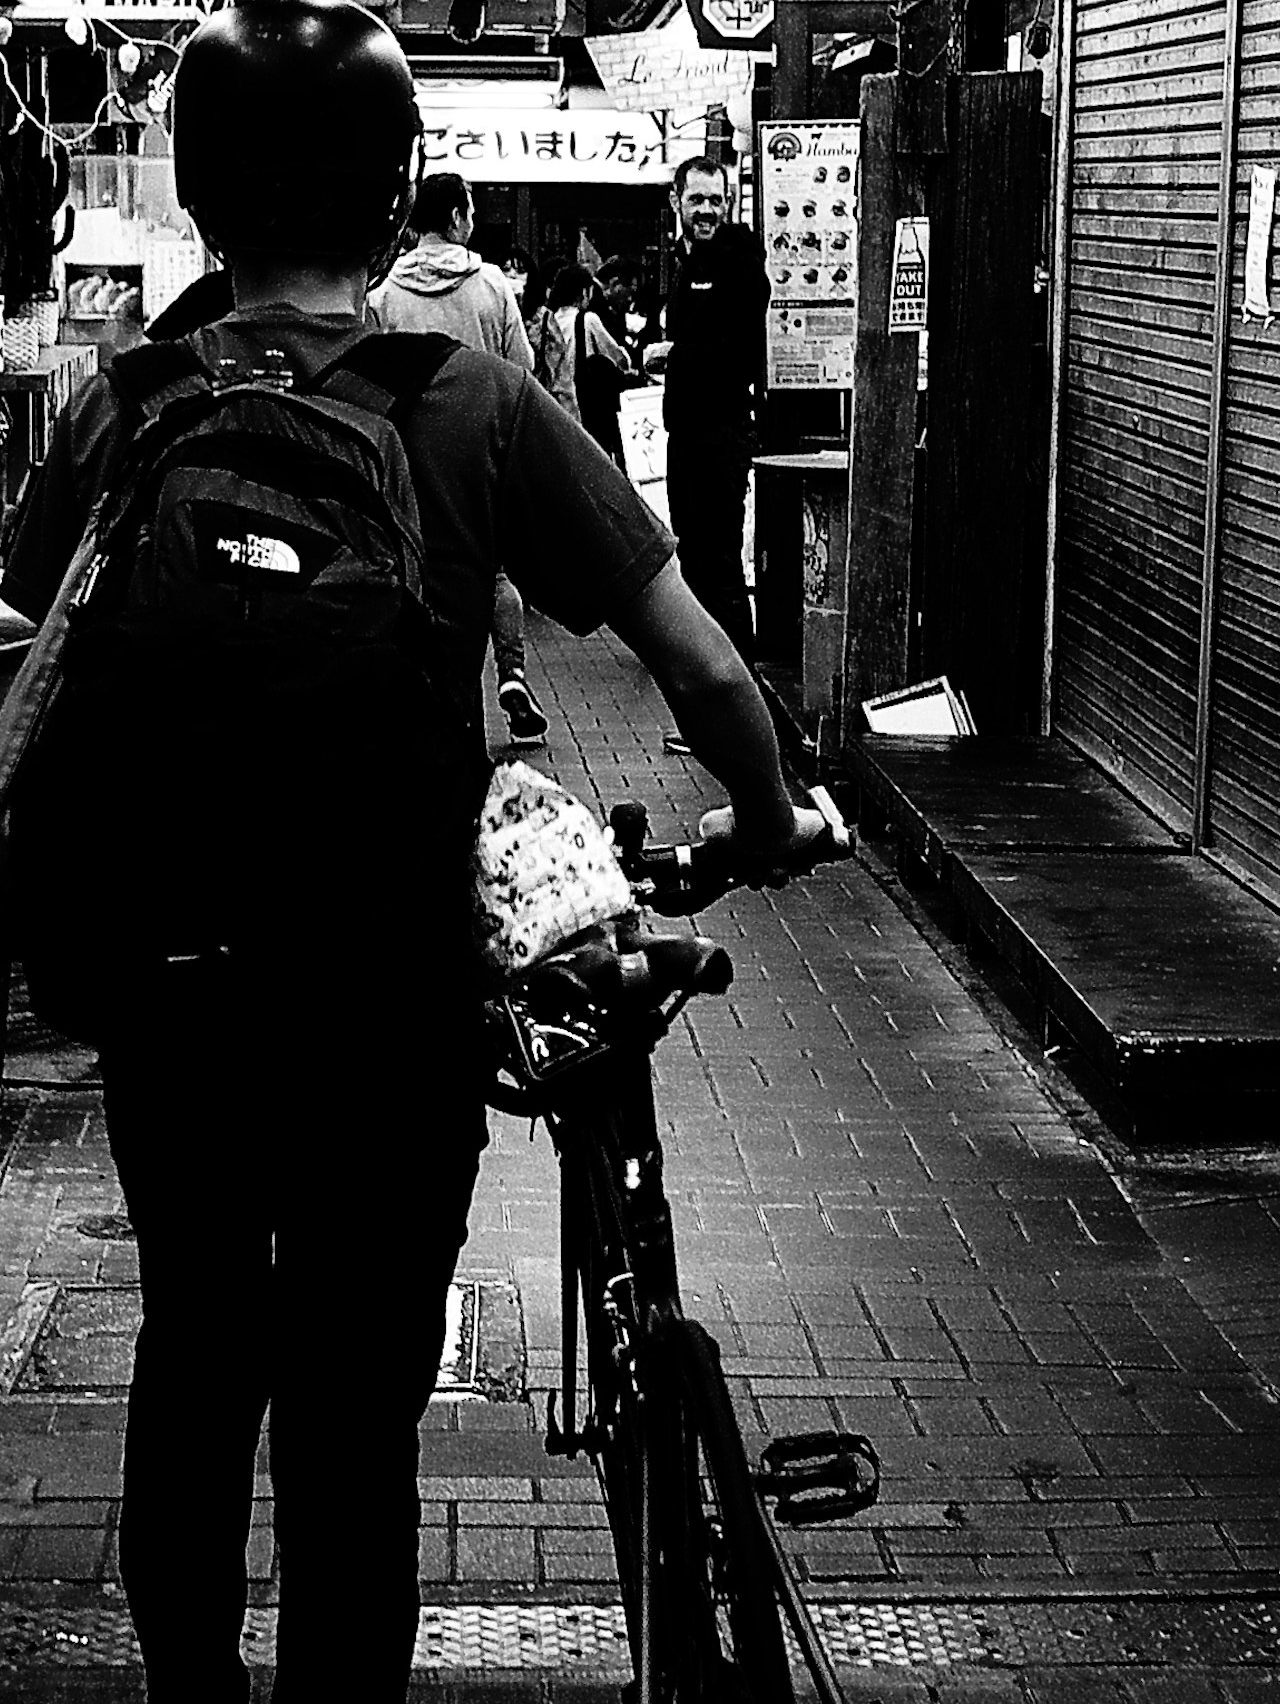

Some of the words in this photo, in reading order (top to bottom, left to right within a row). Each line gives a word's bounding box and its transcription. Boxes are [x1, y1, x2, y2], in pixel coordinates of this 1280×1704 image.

[896, 271, 924, 283] TAKE
[896, 284, 922, 296] OUT
[246, 534, 276, 551] THE
